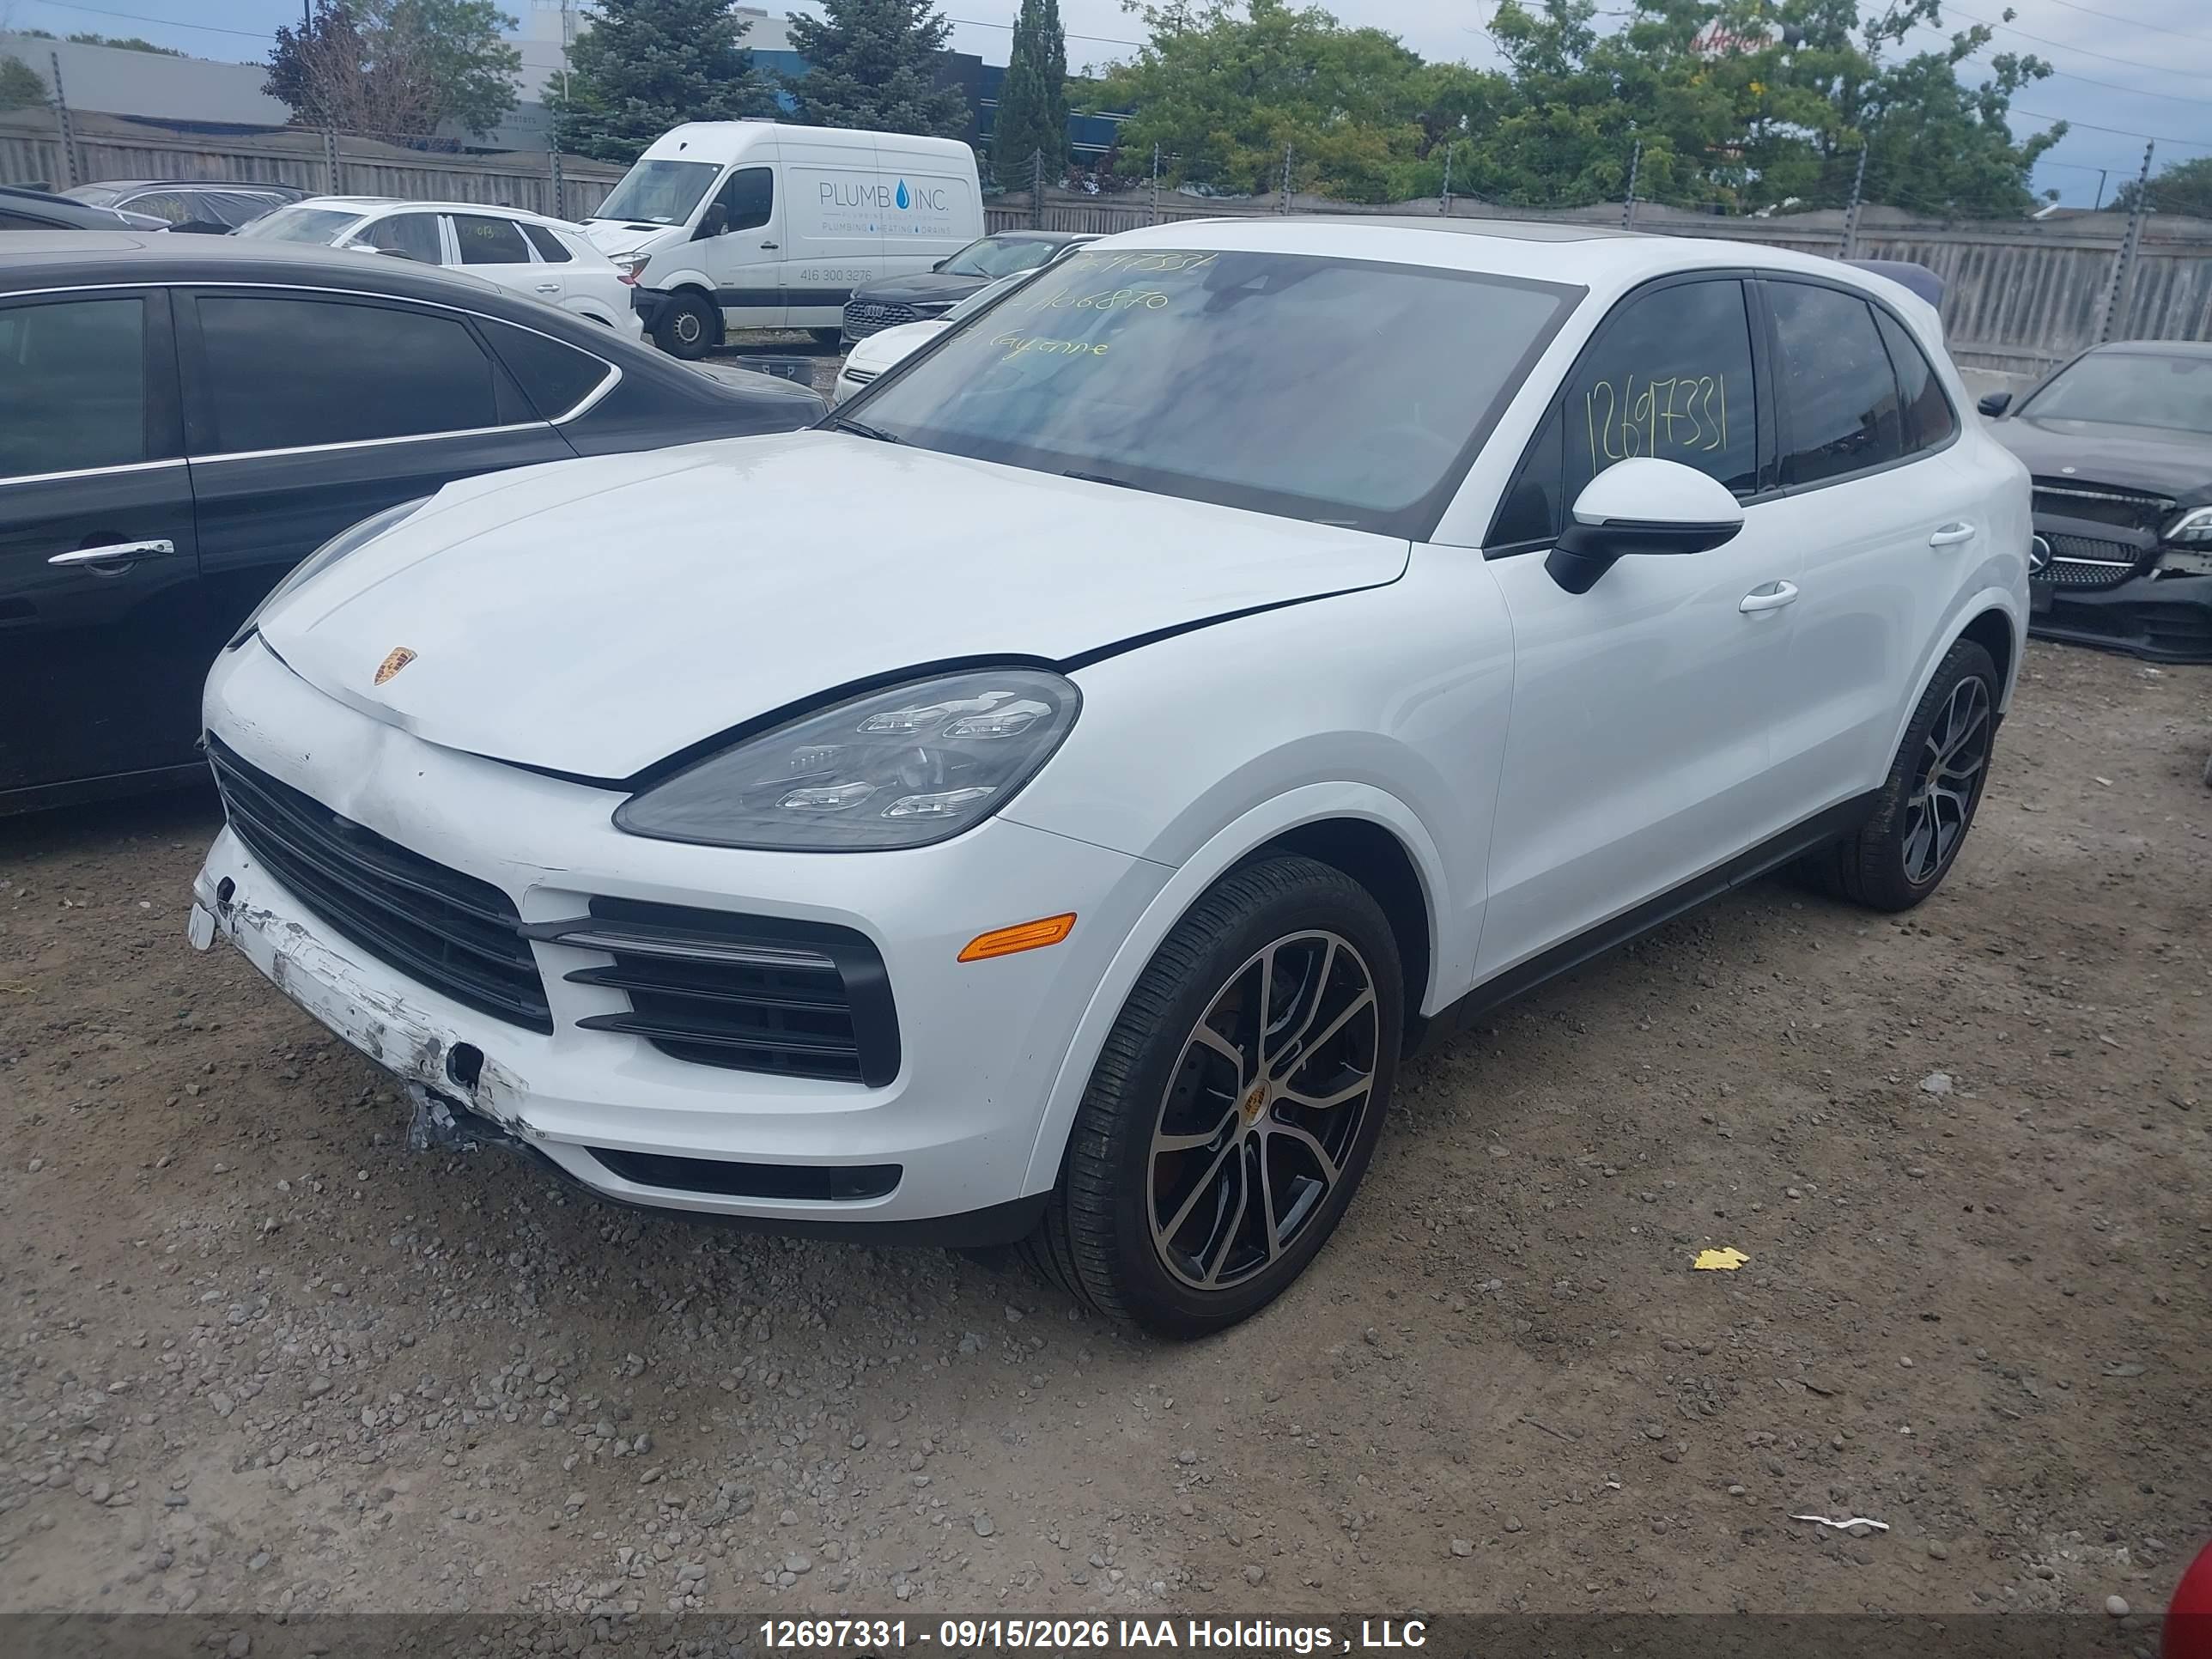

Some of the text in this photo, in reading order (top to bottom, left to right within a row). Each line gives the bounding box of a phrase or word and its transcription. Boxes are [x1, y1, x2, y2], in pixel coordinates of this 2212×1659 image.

[819, 181, 949, 211] PLUMB INC.
[822, 222, 951, 235] PLUMBING HEATING DRAINS
[799, 268, 872, 283] 416 300 3276
[1586, 373, 1728, 477] 12697331
